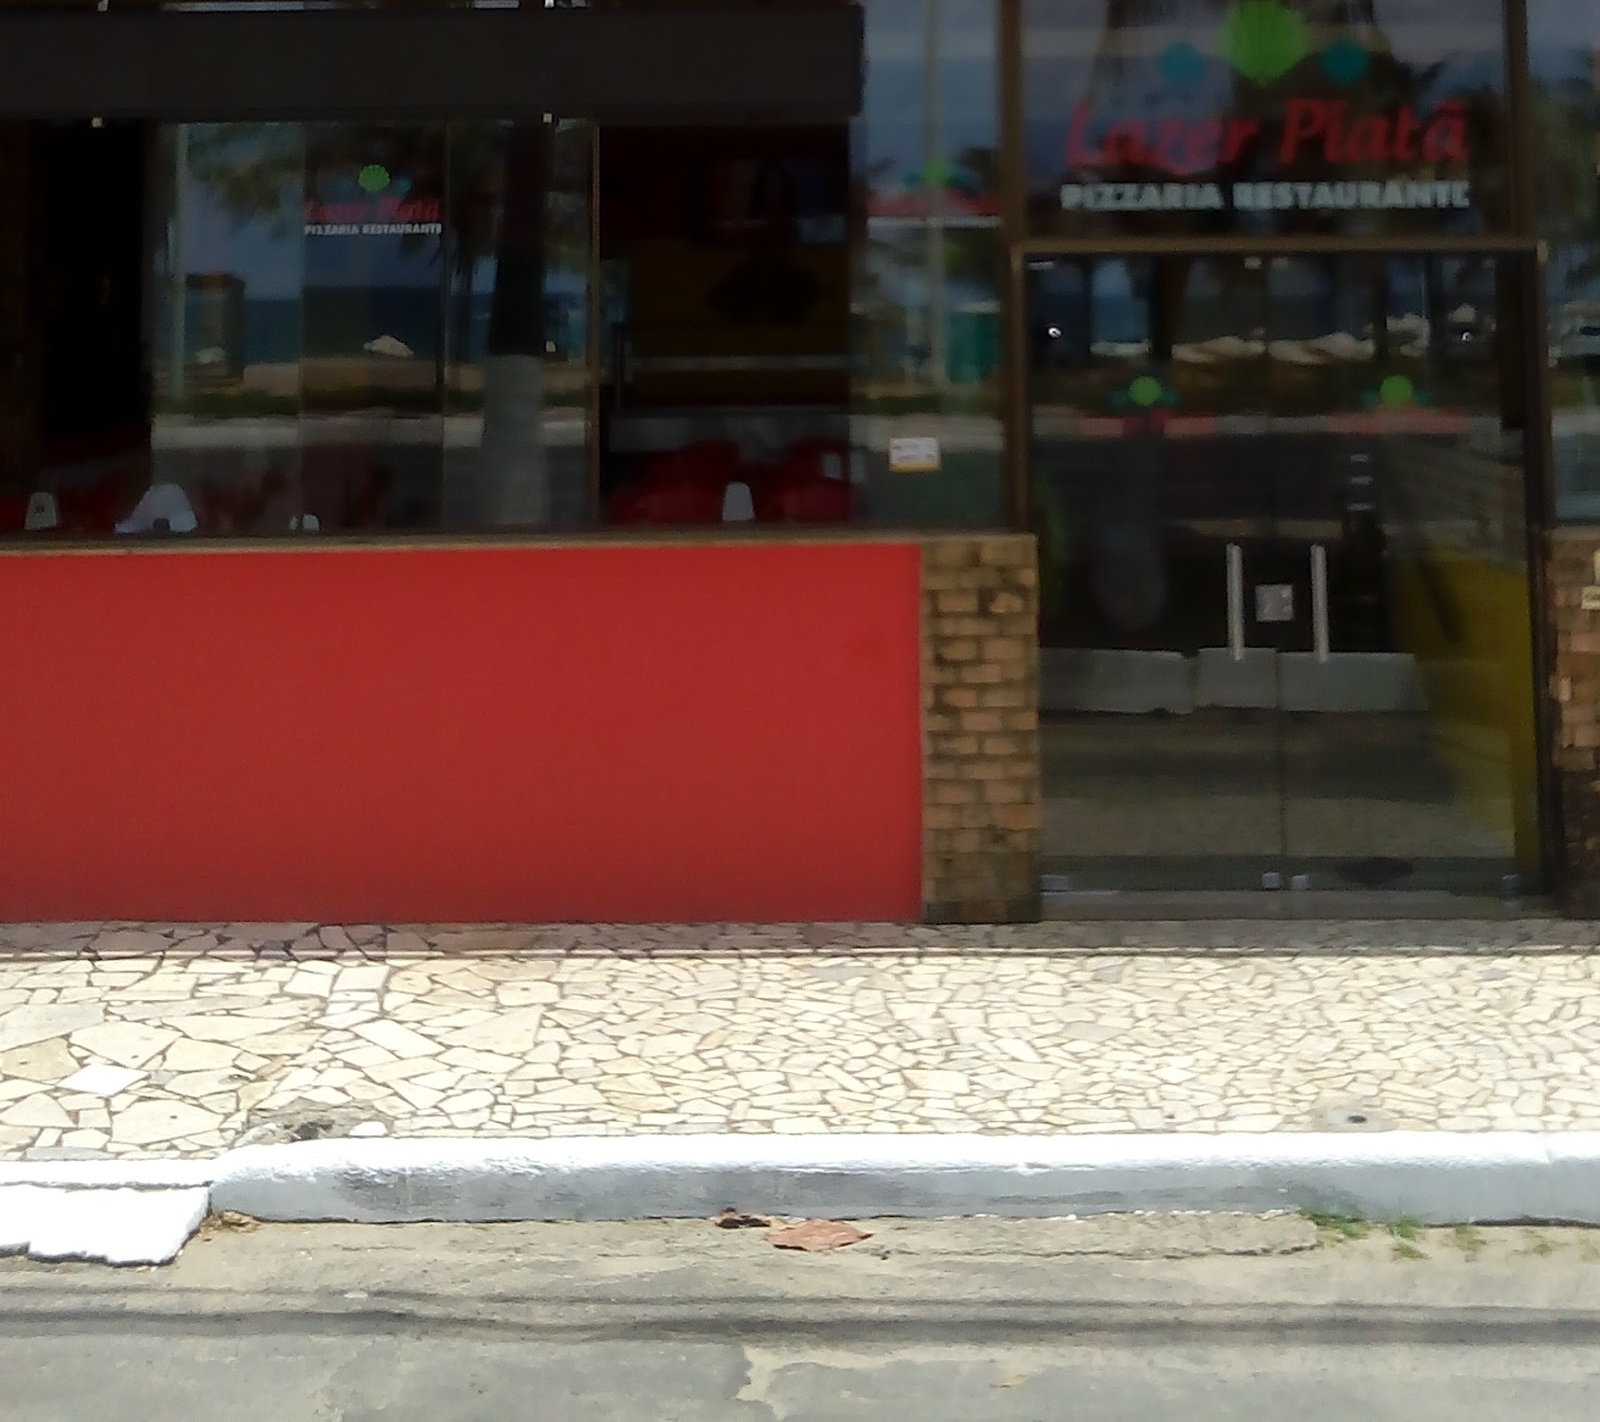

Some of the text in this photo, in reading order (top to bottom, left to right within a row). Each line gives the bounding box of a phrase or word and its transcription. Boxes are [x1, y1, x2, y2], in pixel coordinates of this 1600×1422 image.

[1065, 95, 1470, 176] Lazer Piatã
[1232, 179, 1471, 210] RESTAURANTE
